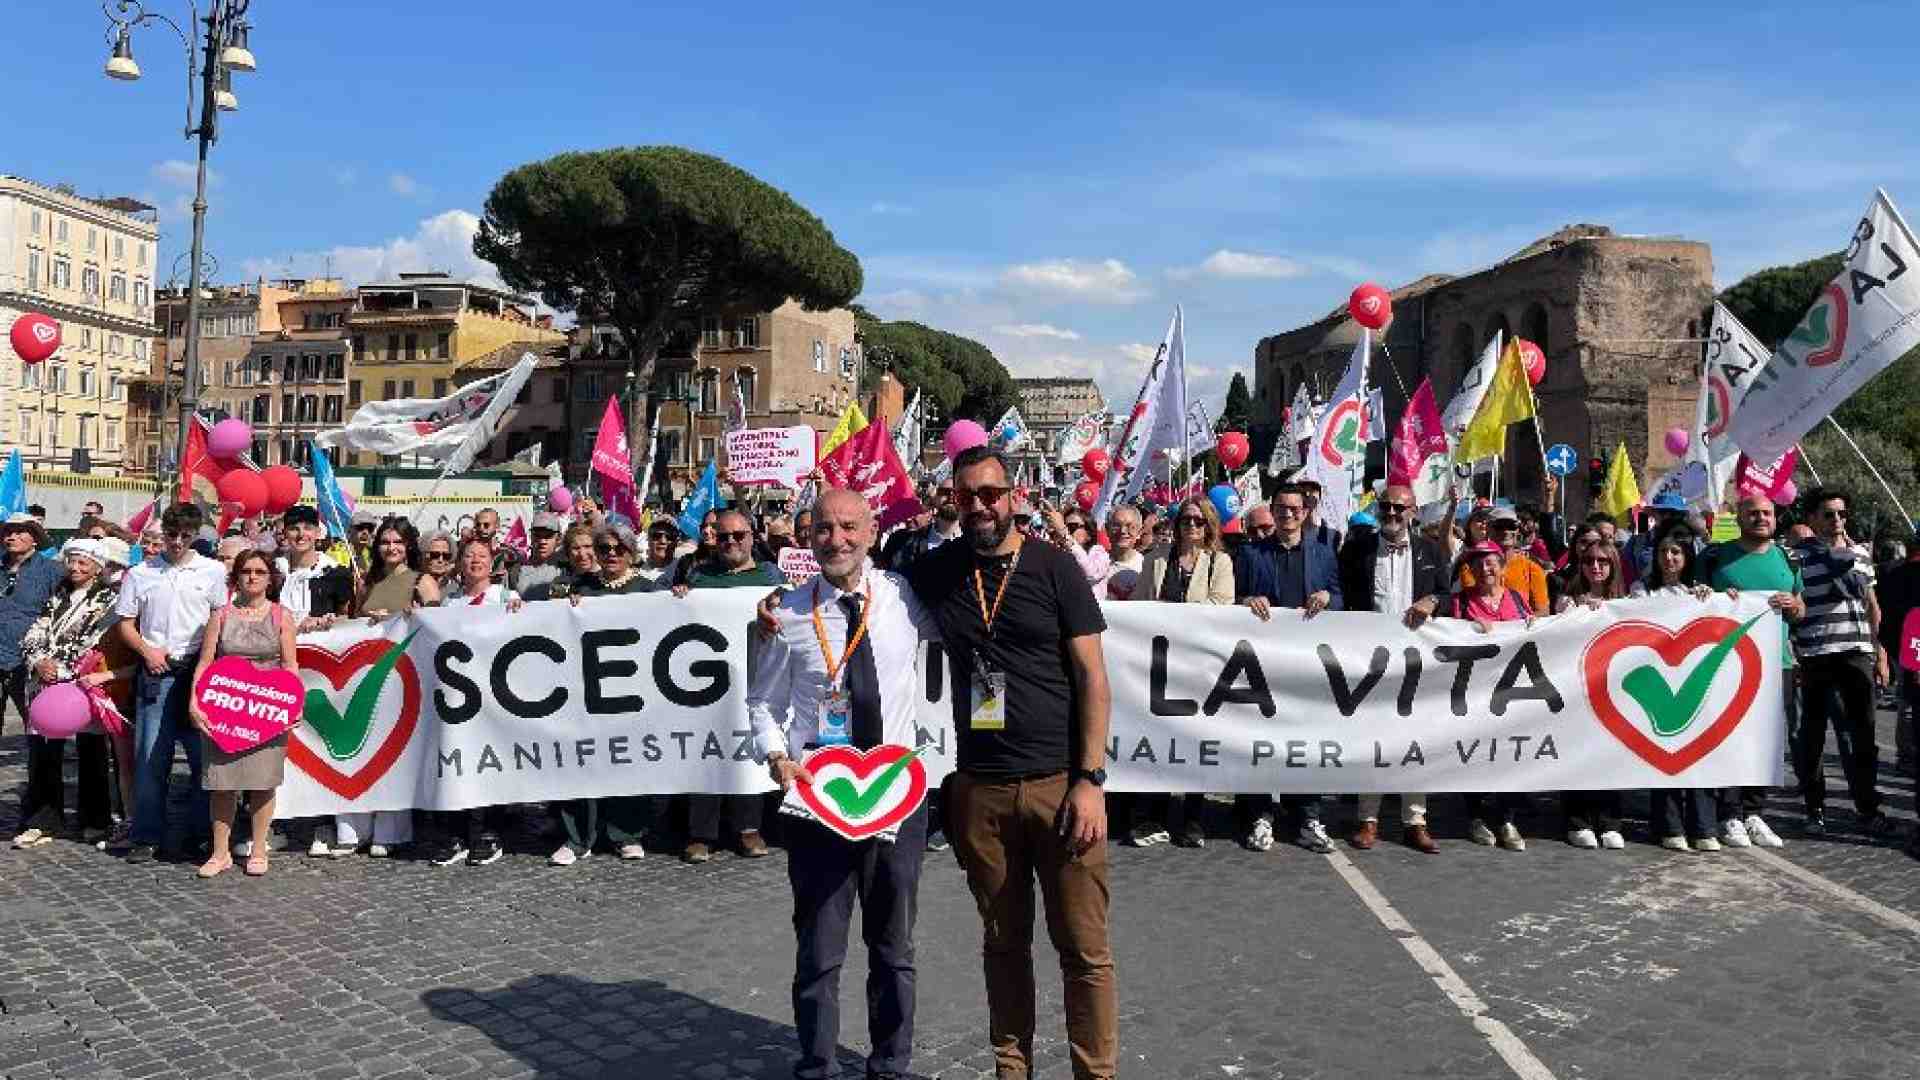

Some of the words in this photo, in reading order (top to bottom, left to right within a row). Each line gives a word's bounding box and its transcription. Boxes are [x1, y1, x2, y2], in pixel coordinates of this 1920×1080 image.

[208, 674, 297, 705] generazione
[433, 623, 732, 725] SCEG
[1150, 635, 1277, 718] LA
[1316, 640, 1565, 718] VITA
[202, 688, 246, 712] PRO
[248, 699, 289, 725] VITA
[438, 729, 753, 778] MANIFESTAZ
[1251, 739, 1344, 768] PER
[1374, 739, 1426, 768] LA
[1456, 733, 1559, 763] VITA
